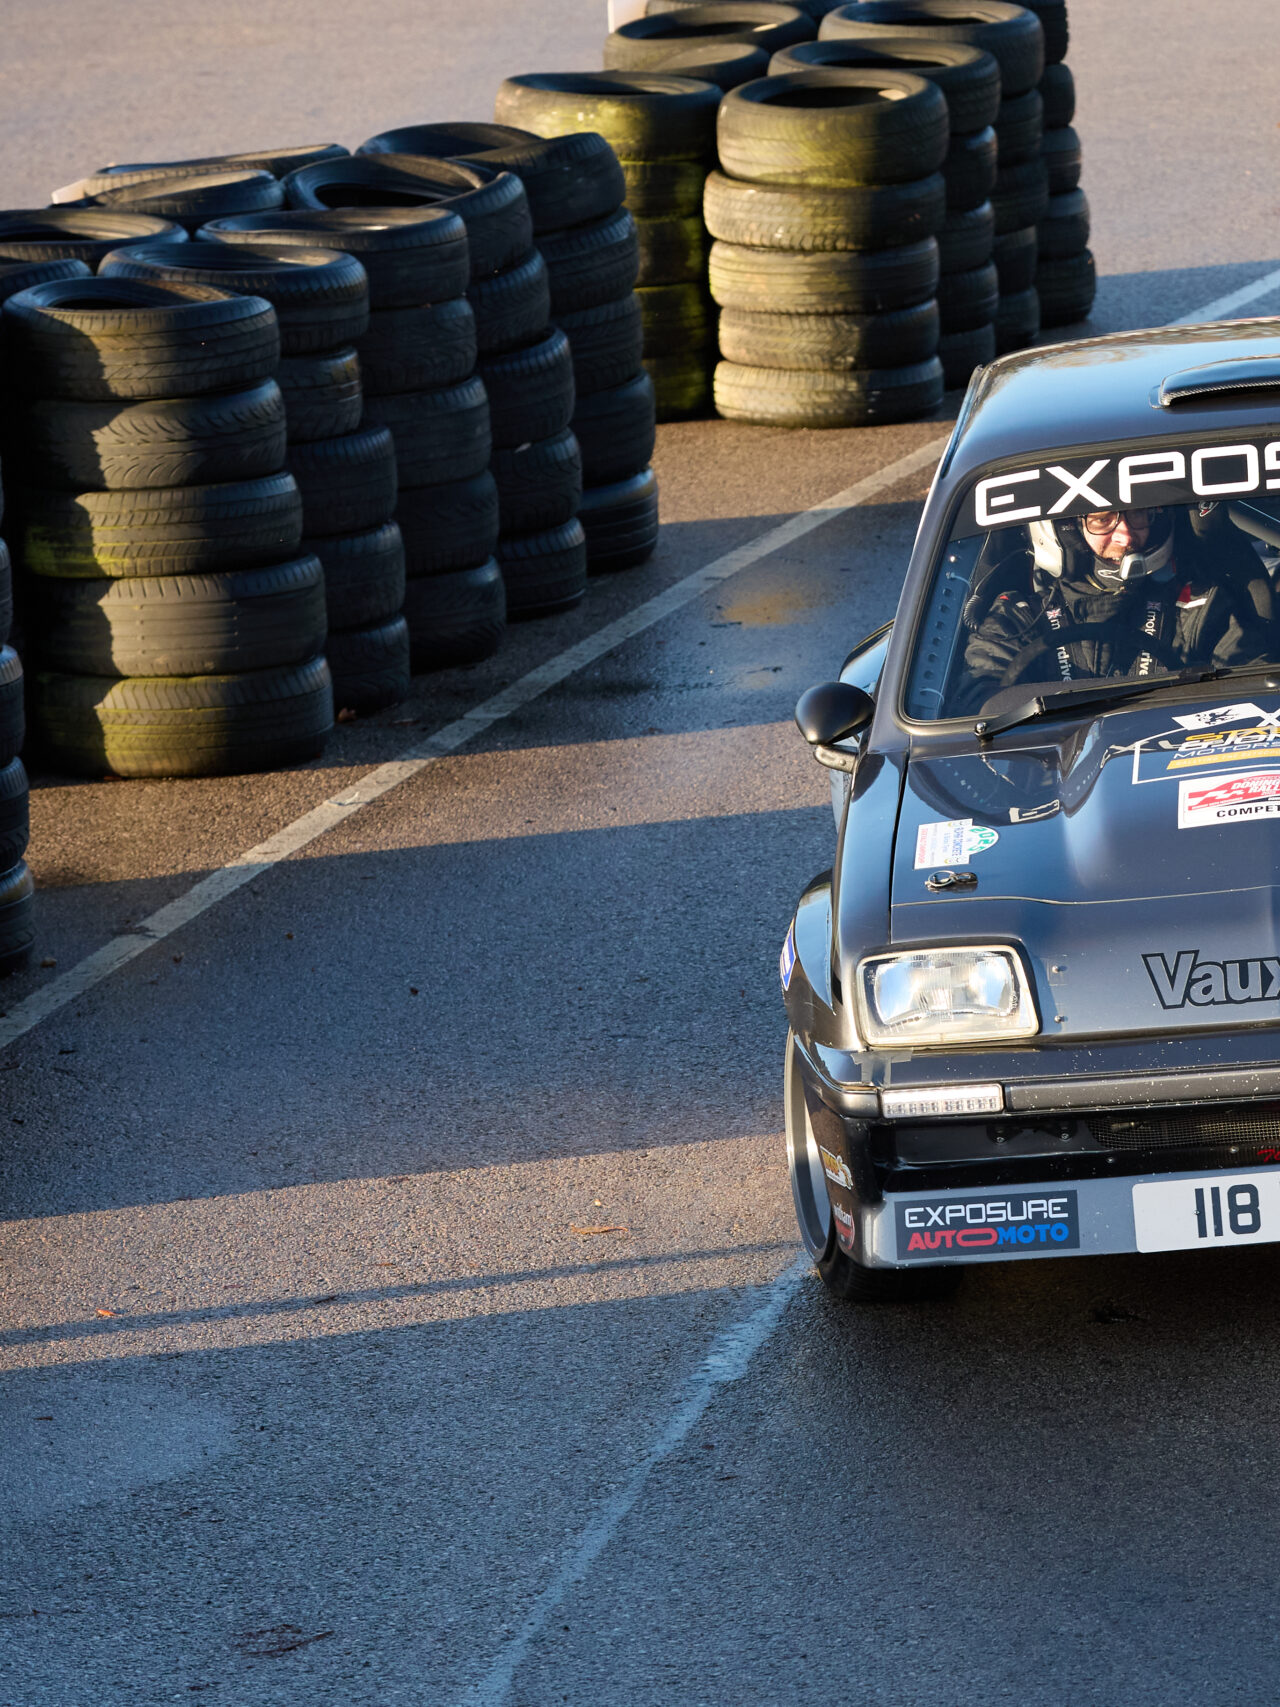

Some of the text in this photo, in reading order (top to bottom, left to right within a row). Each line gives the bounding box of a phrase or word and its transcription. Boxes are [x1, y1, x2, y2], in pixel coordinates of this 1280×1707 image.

[968, 826, 996, 852] 2025
[905, 1198, 1069, 1228] EXPOSURE
[1194, 1184, 1261, 1238] 118
[907, 1222, 1070, 1251] AUTOMOTO
